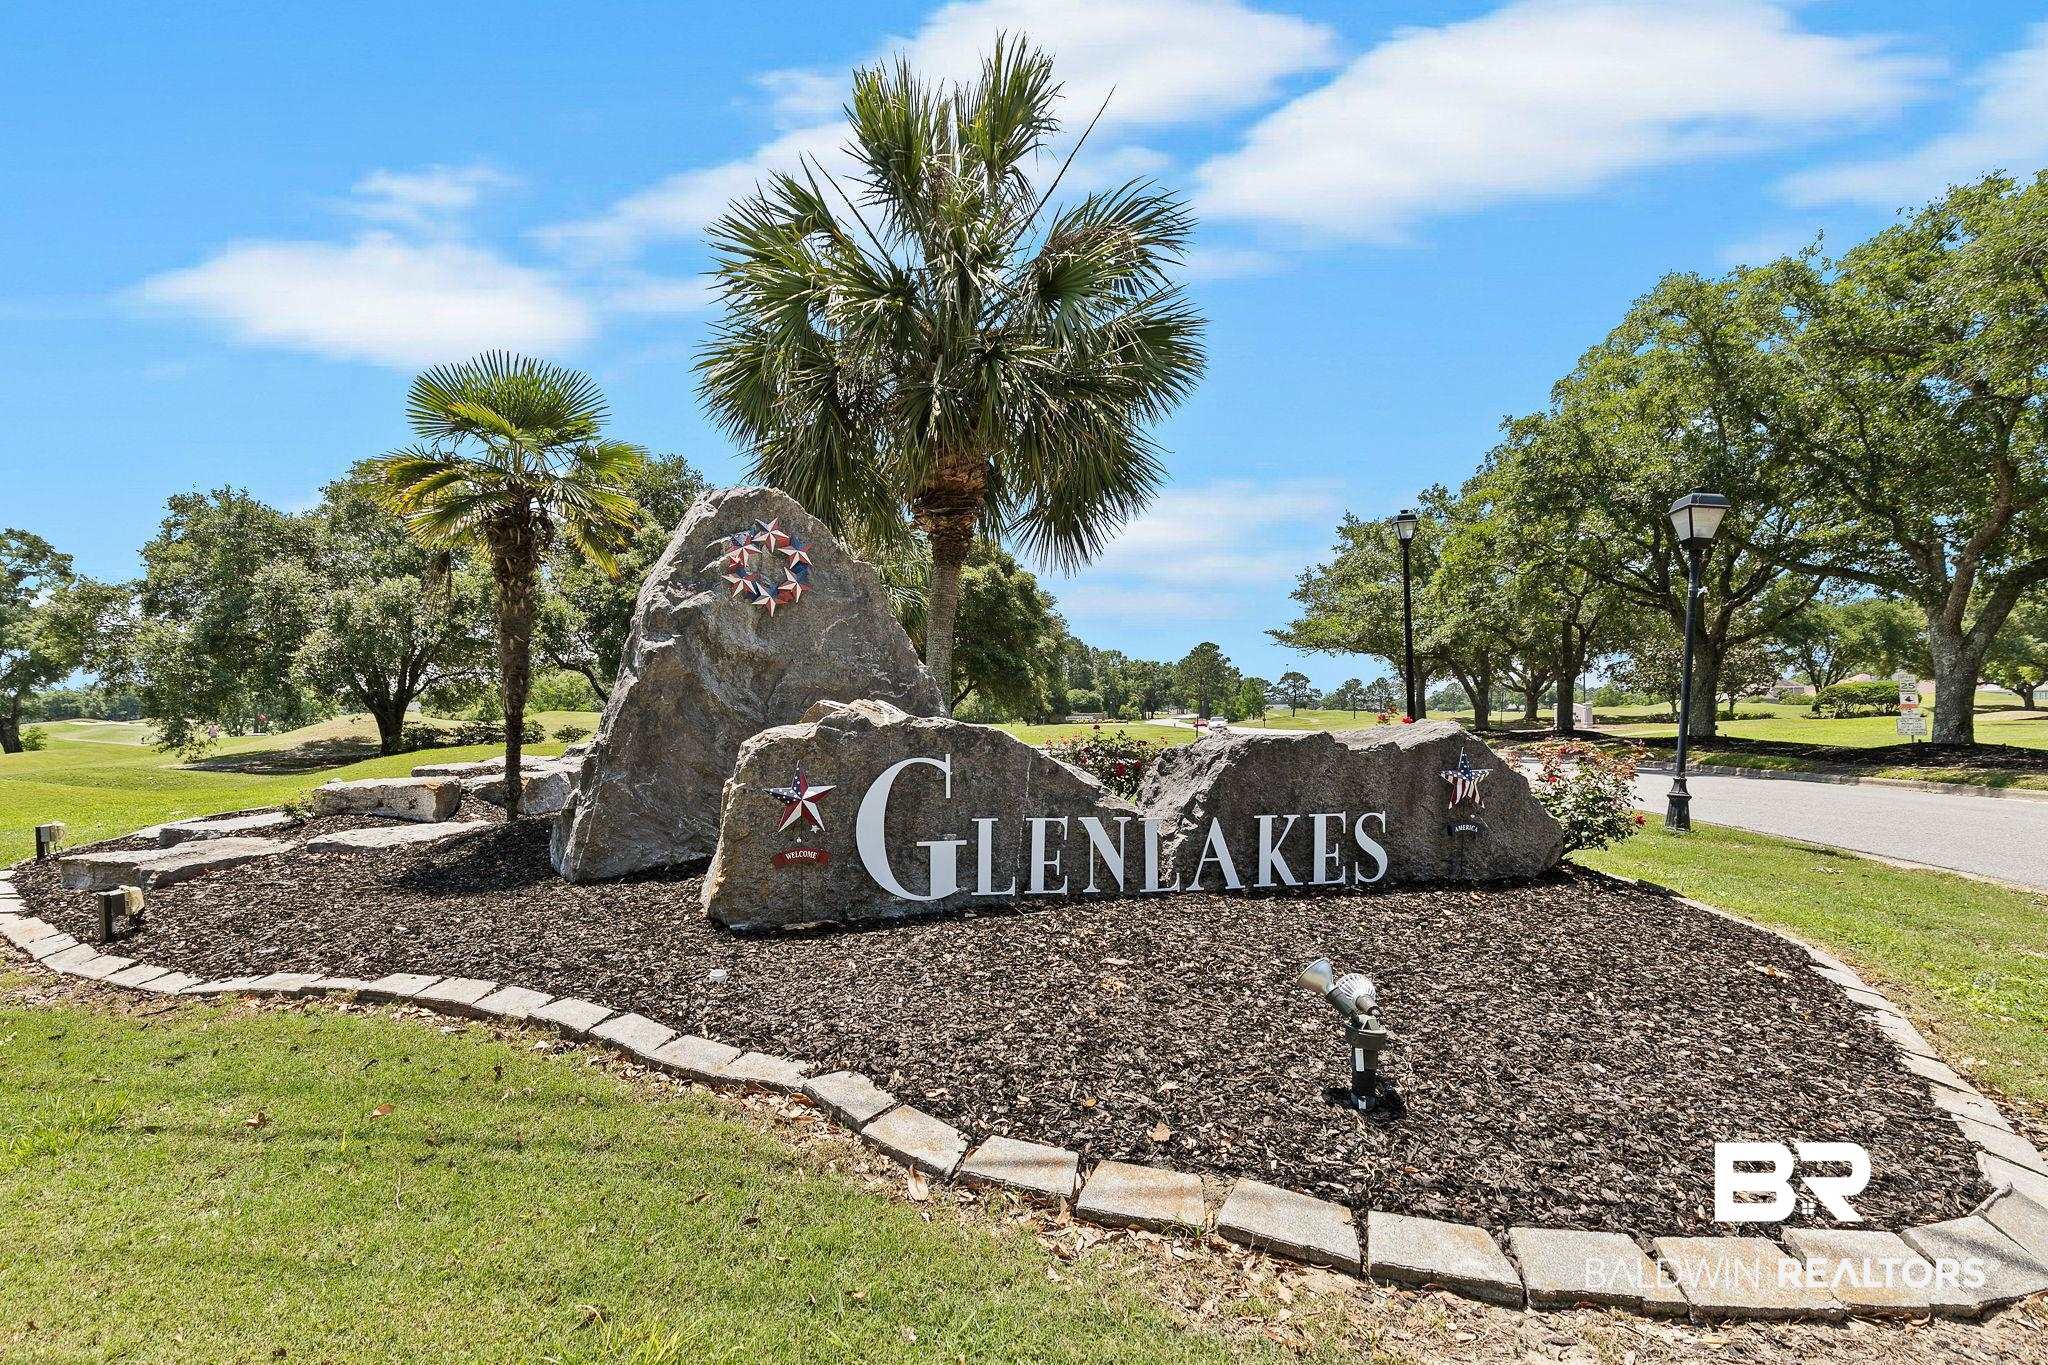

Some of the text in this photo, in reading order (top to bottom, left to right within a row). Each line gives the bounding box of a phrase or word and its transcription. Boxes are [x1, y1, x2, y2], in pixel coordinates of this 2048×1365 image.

[855, 753, 1388, 902] GLENLAKES
[1454, 824, 1478, 832] AMERICA
[785, 851, 818, 860] WELCOME
